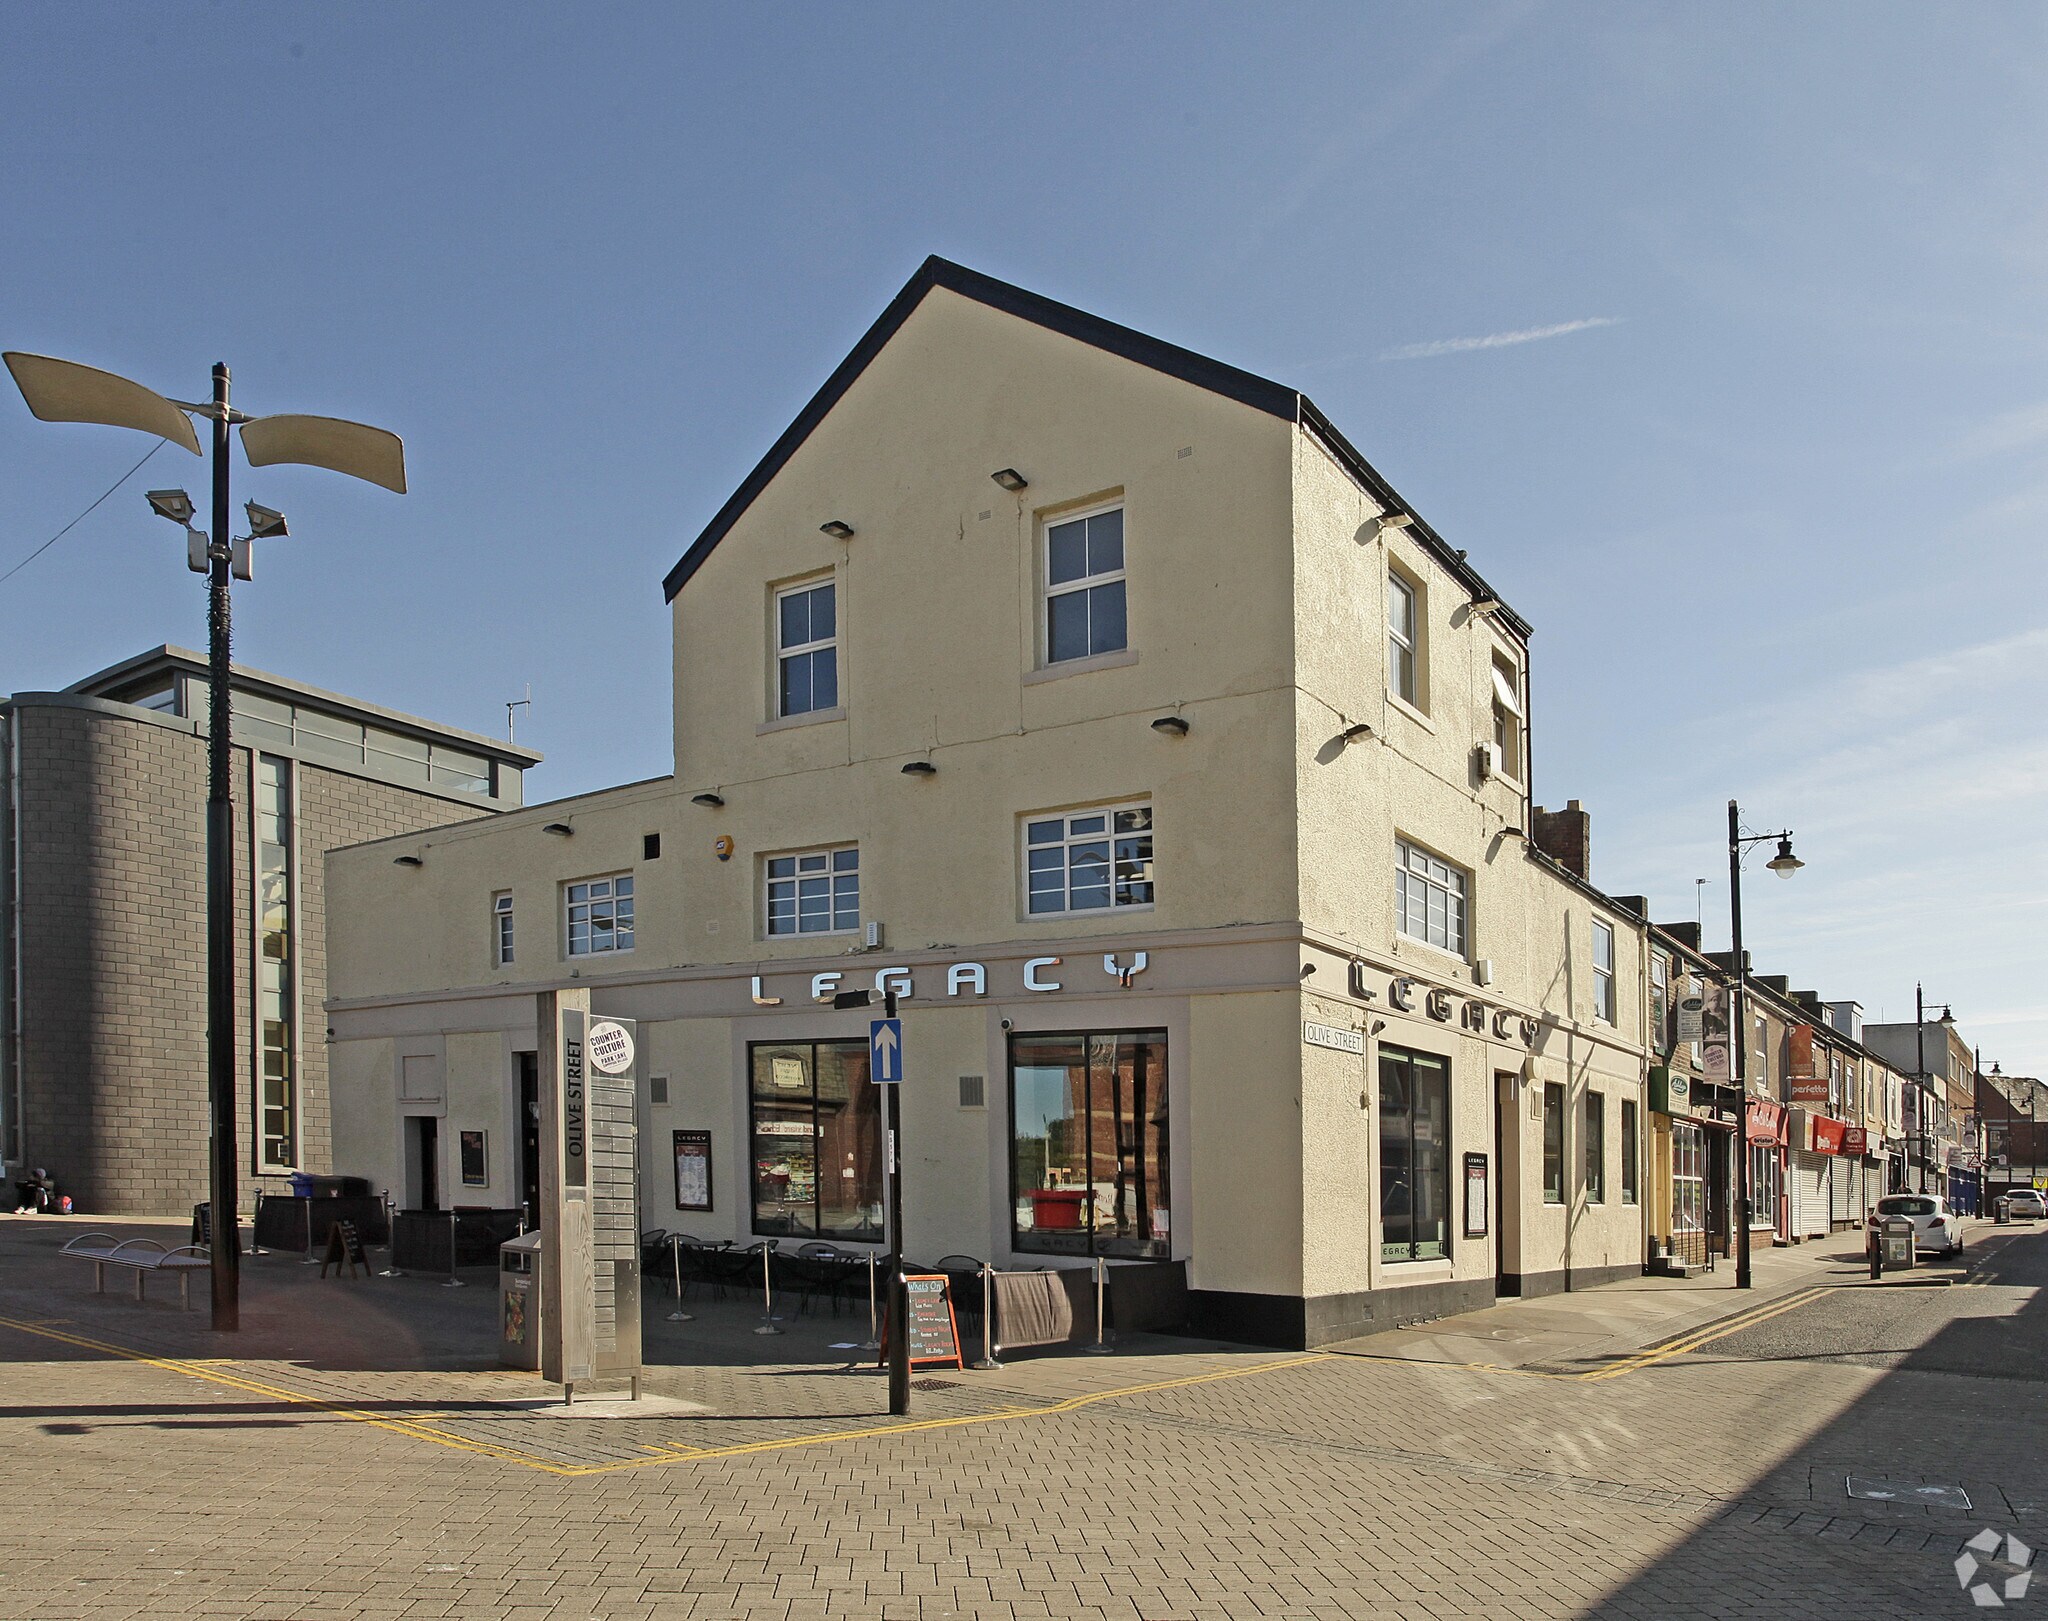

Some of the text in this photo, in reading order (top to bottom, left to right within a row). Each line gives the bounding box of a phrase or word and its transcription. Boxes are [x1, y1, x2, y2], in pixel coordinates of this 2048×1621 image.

[751, 951, 1148, 1005] LEGACY
[1350, 959, 1541, 1048] LEGACY
[590, 1030, 623, 1046] COUNTER
[1307, 1024, 1362, 1050] OLIVE STREET
[593, 1039, 626, 1057] CULTURE
[600, 1055, 614, 1064] PARK
[567, 1038, 583, 1157] OLIVE STREET
[1792, 1085, 1828, 1096] perfetto
[1382, 1246, 1411, 1256] EGACY
[929, 1281, 941, 1290] On
